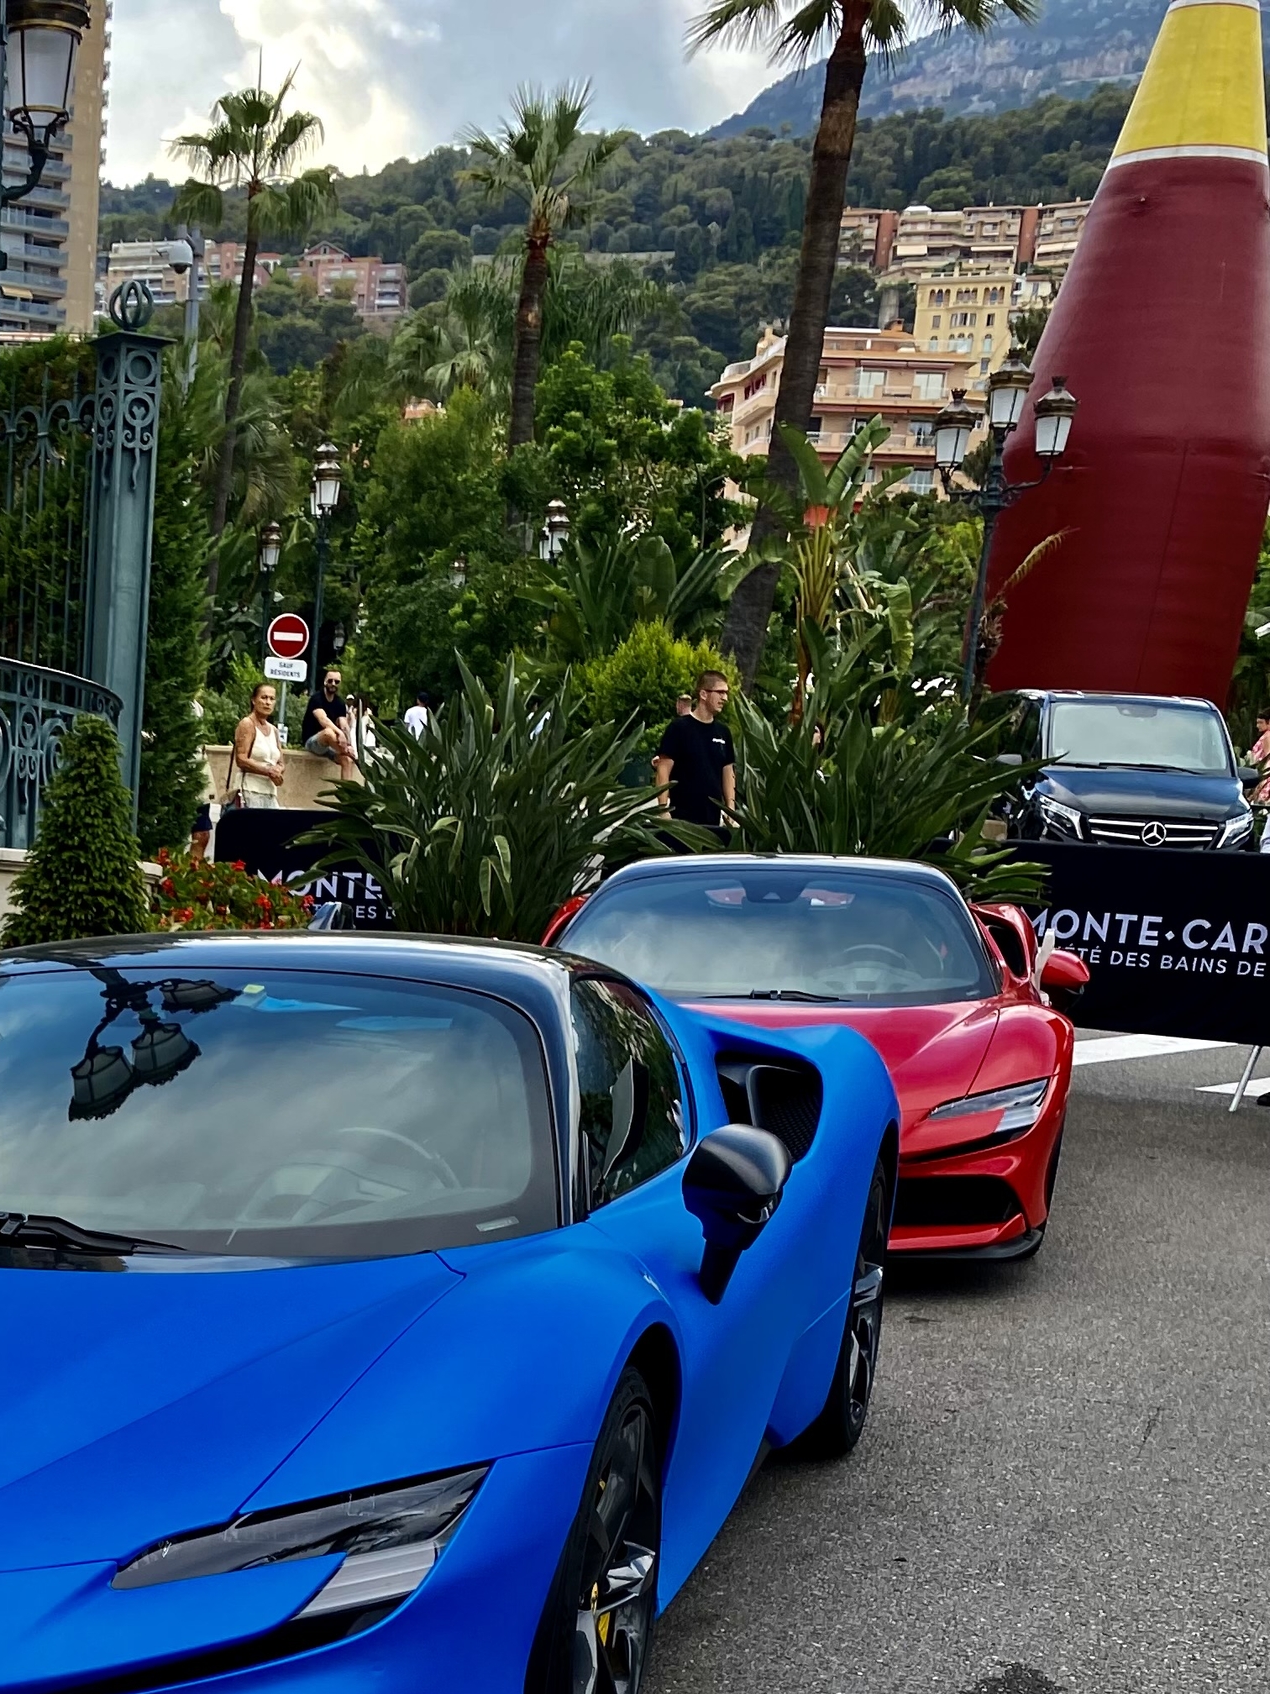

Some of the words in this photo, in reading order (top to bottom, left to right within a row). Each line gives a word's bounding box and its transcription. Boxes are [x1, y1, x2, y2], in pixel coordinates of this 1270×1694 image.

[1110, 950, 1151, 968] DES
[1160, 955, 1228, 974] BAINS
[1237, 961, 1267, 977] DE
